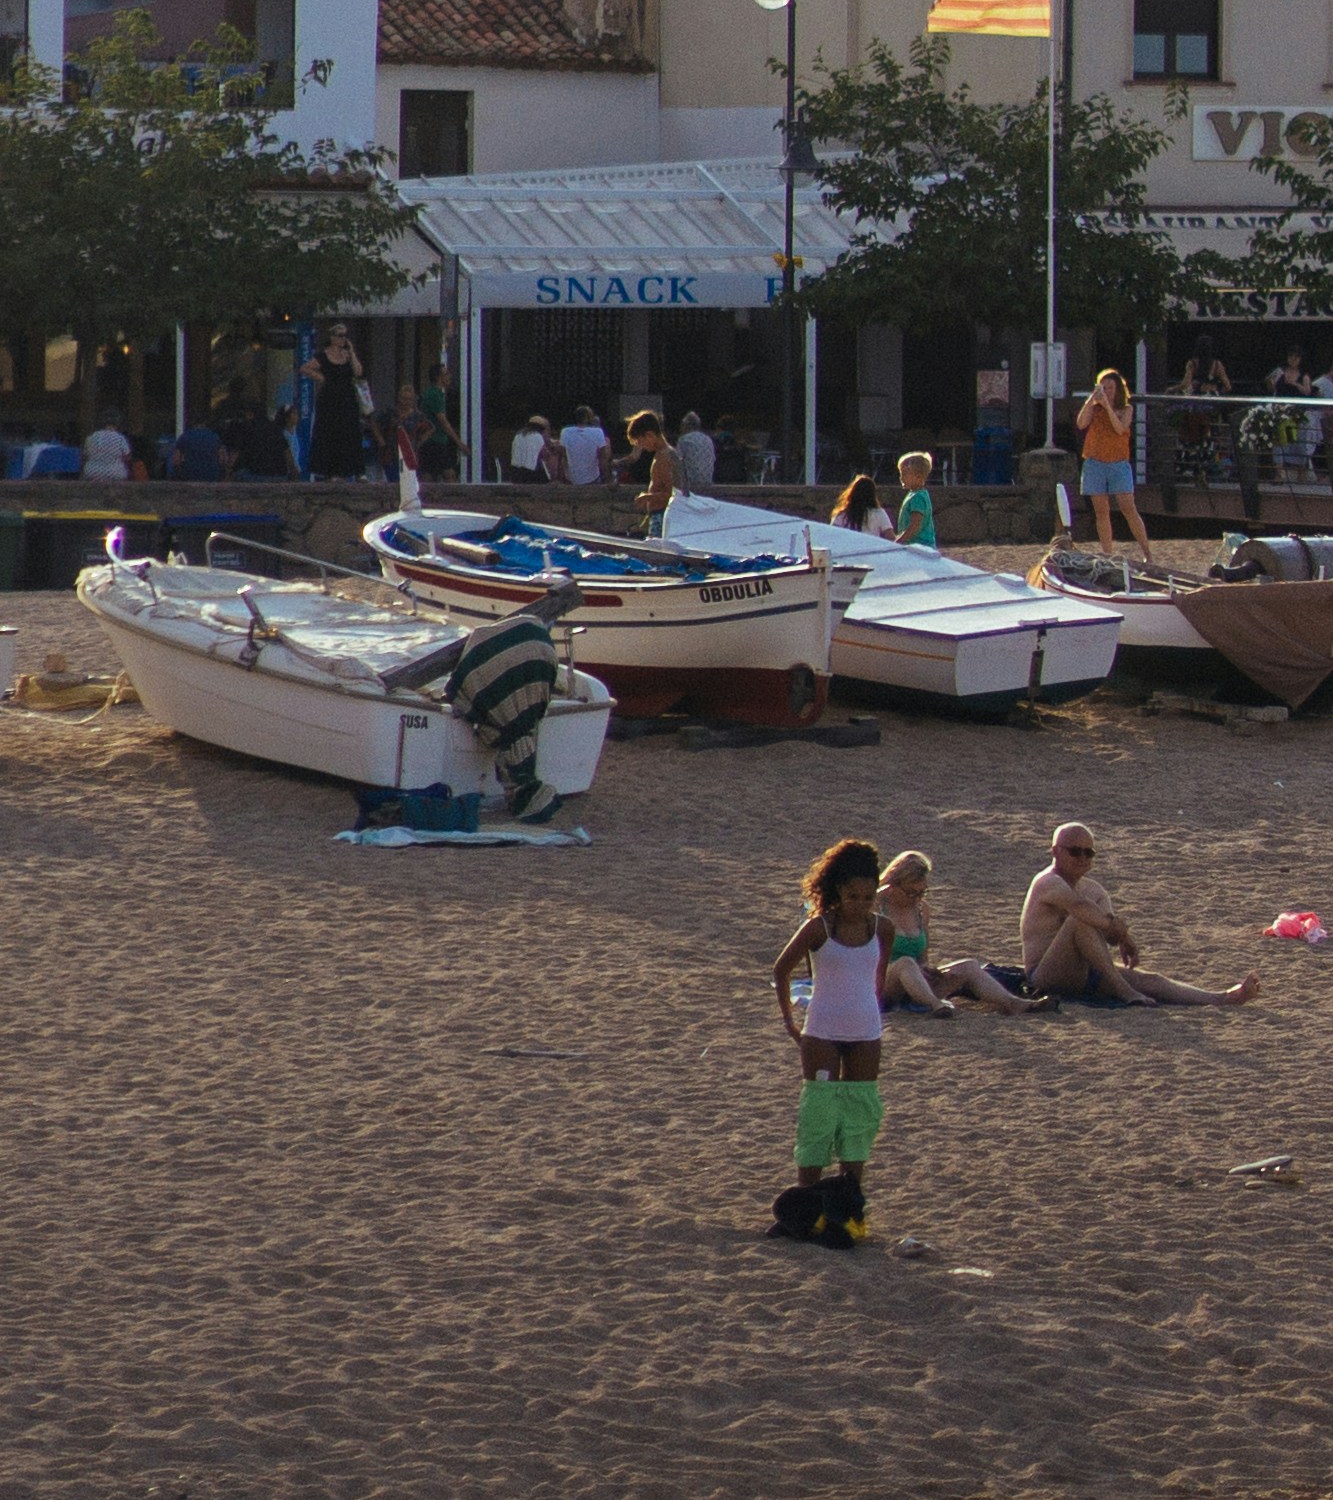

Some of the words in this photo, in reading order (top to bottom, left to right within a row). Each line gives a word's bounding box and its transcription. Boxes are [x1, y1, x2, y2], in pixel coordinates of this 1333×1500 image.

[536, 276, 698, 304] SNACK
[699, 579, 773, 604] OBDULIA
[400, 714, 428, 729] SUSA
